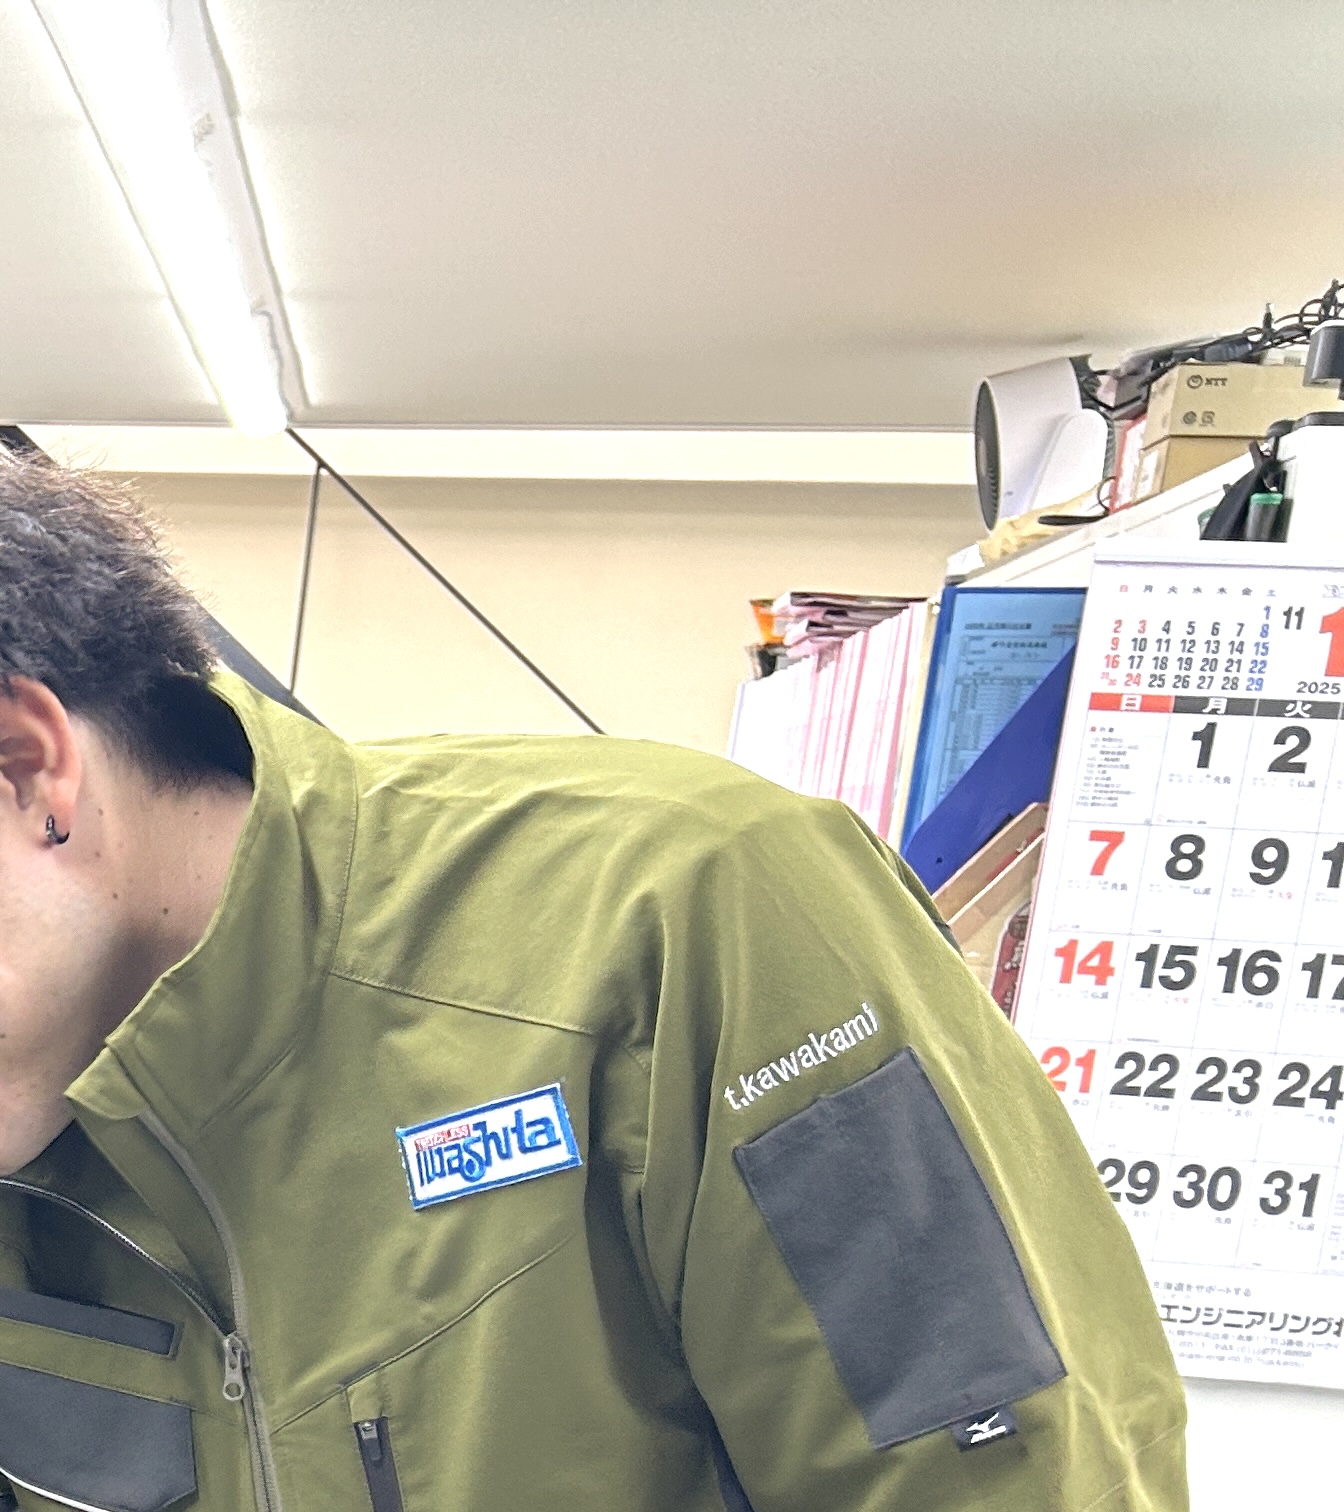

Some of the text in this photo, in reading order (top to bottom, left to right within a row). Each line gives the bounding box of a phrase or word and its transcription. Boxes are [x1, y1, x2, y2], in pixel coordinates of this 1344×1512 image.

[1205, 377, 1228, 387] NTT
[1113, 619, 1270, 638] 2 3 4 5 6 7 8
[1282, 606, 1305, 630] 11
[1110, 637, 1270, 656] 9 10 11 12 13 14 15
[1104, 654, 1268, 674] 16 17 18 19 20 21 22
[1124, 673, 1142, 687] 24
[1148, 674, 1166, 688] 25
[1172, 675, 1191, 689] 26
[1196, 676, 1214, 690] 27
[1221, 677, 1239, 691] 28
[1245, 677, 1264, 692] 29
[1296, 681, 1342, 695] 2025
[1121, 694, 1313, 718] 日 月 火
[1191, 721, 1218, 769] 1
[1267, 725, 1312, 774] 2
[1088, 829, 1126, 876] 7
[1165, 834, 1206, 881] 8
[1249, 837, 1290, 886] 9
[1054, 938, 1116, 987] 14
[1135, 943, 1200, 991] 15
[1216, 947, 1283, 996] 16
[724, 1002, 879, 1110] t.kawakami
[1036, 1045, 1344, 1110] 21 22 23 24
[1096, 1157, 1321, 1218] 29 30 31
